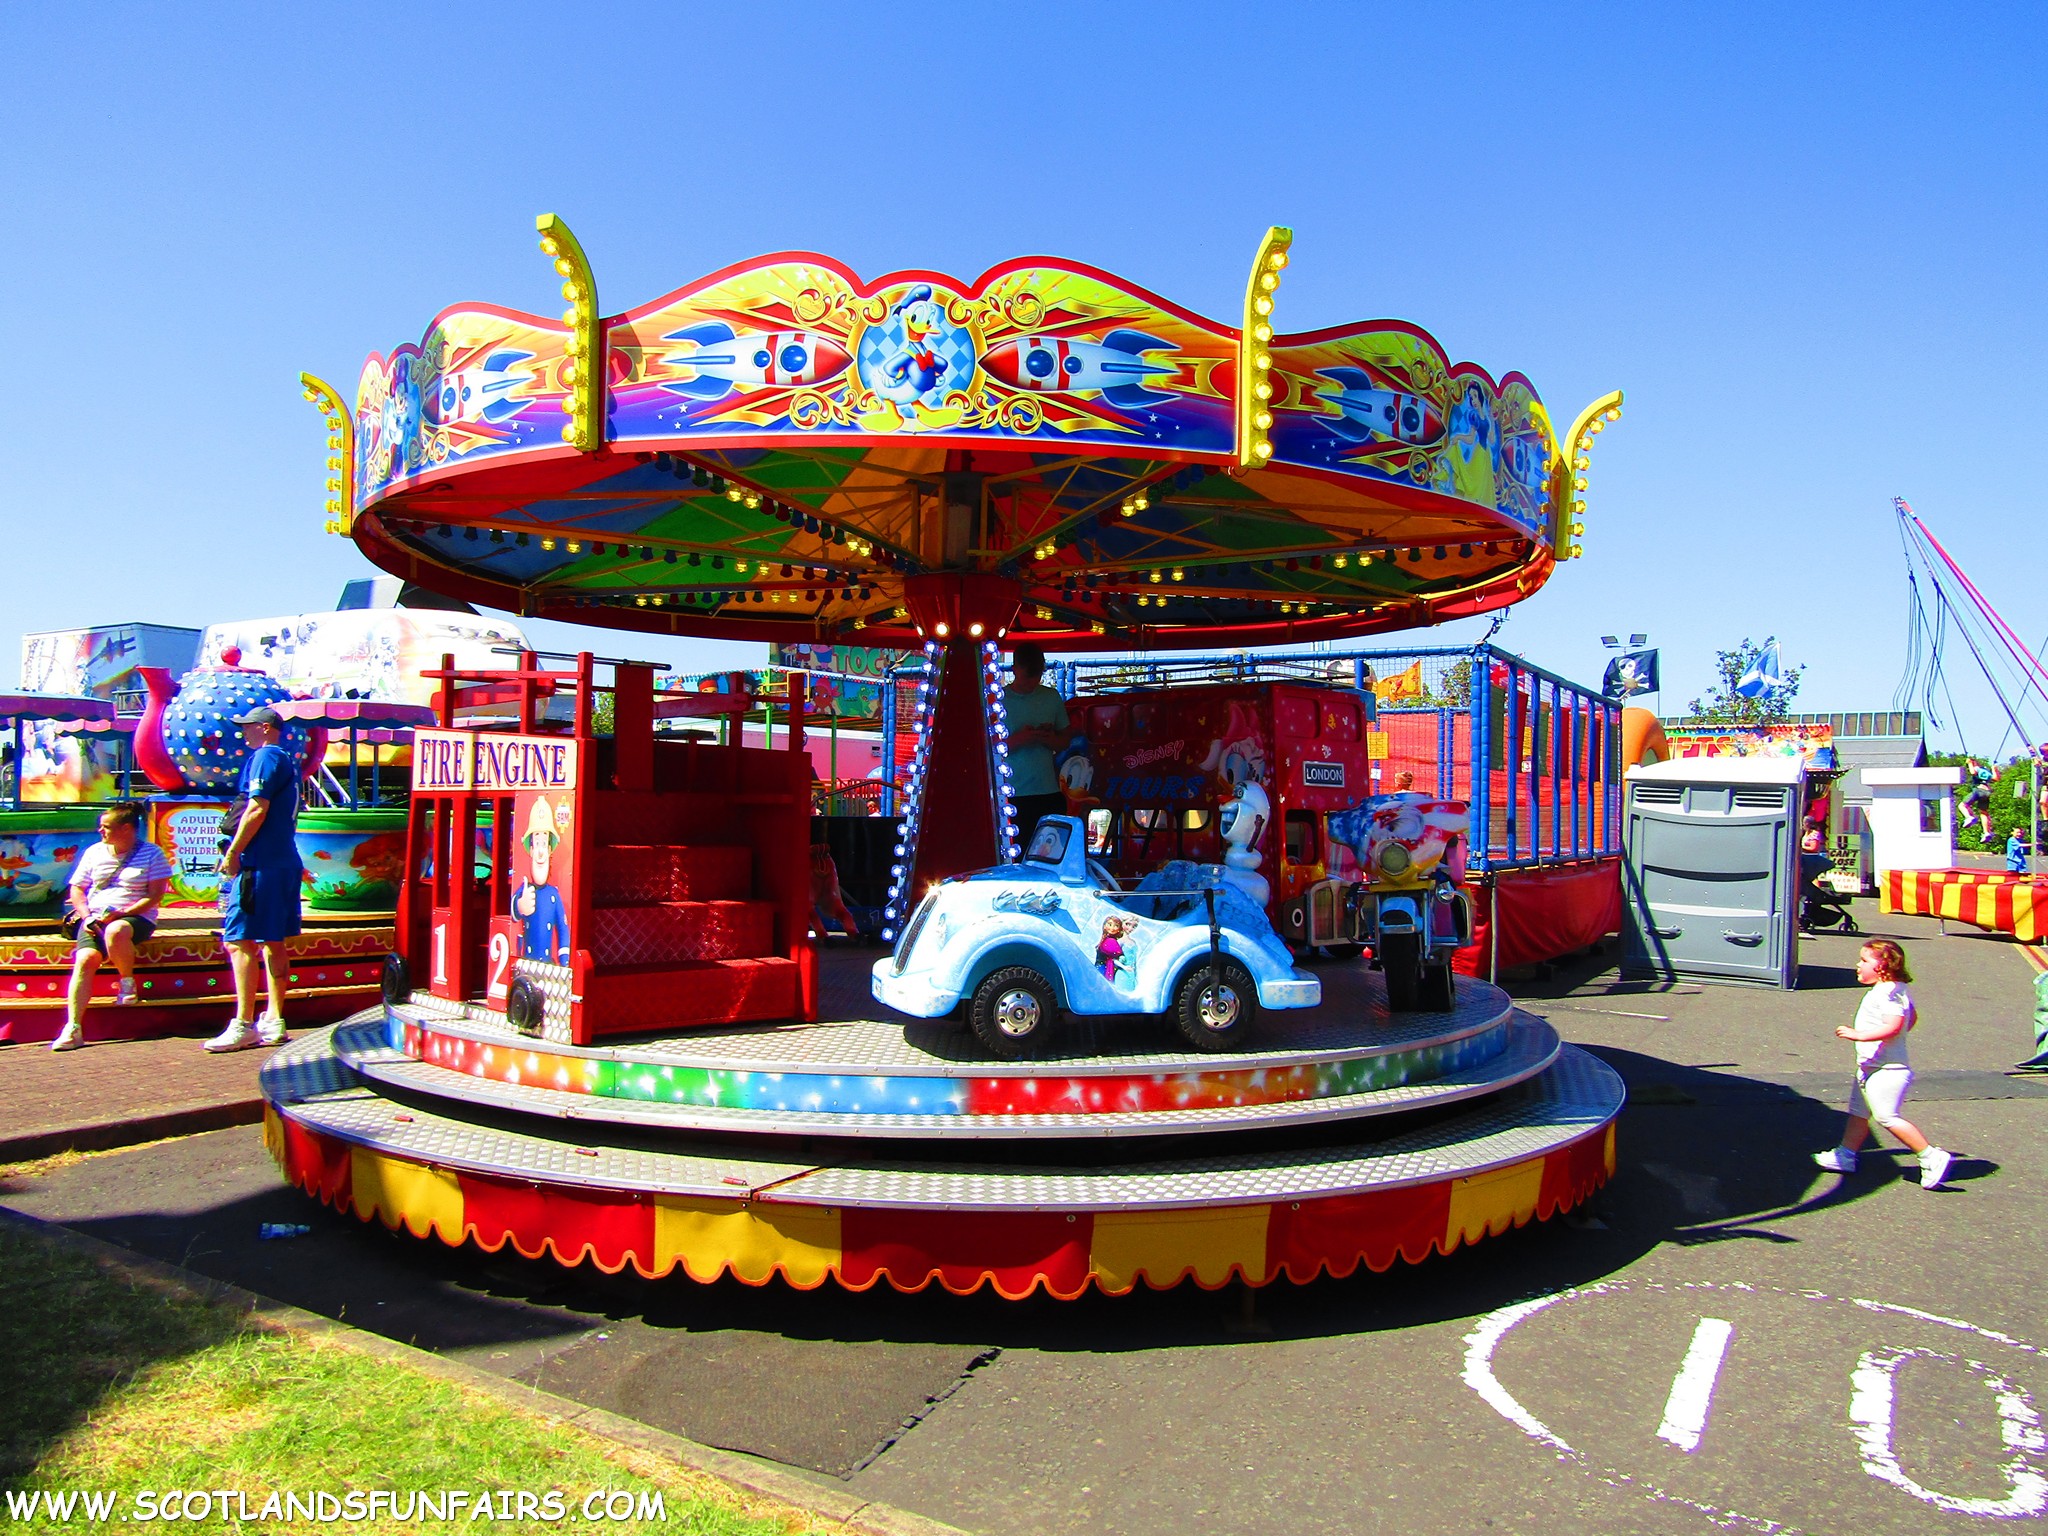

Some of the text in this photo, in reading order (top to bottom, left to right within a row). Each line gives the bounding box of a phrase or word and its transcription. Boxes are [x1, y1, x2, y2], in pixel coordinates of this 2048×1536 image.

[418, 738, 566, 788] FIRE ENGINE
[1306, 768, 1342, 780] LONDON
[1106, 776, 1205, 799] TOURS
[178, 826, 222, 834] MAY RIDE
[1837, 836, 1848, 849] U
[434, 923, 448, 986] 1
[488, 932, 511, 1000] 2
